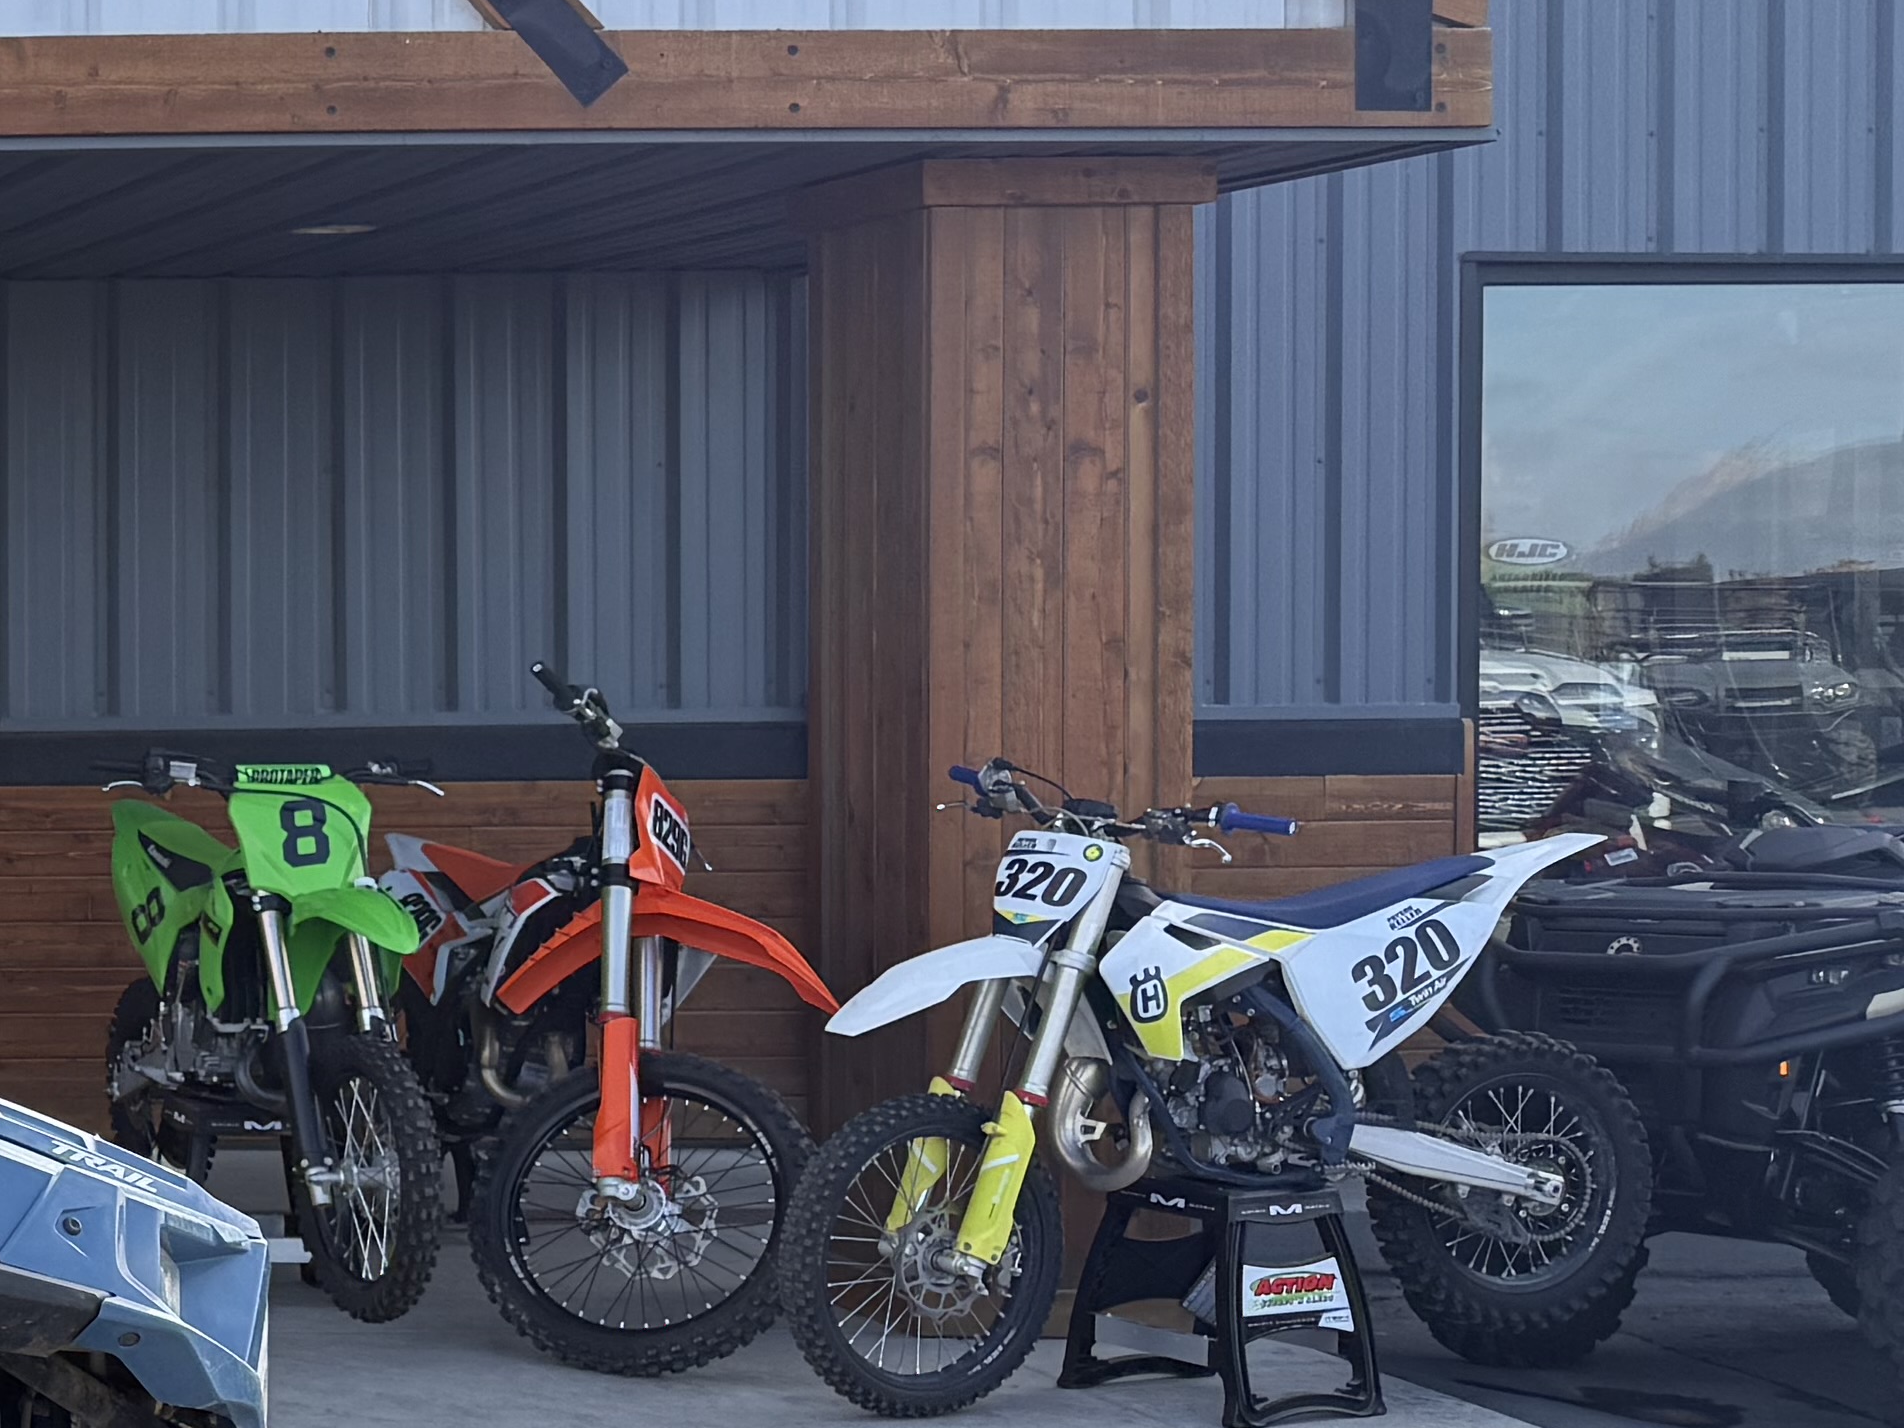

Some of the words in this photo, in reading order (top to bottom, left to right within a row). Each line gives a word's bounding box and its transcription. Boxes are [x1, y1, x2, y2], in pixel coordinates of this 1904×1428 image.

[1494, 543, 1561, 558] HJC
[279, 798, 330, 868] 8
[995, 858, 1088, 907] 320
[1351, 919, 1460, 1012] 320
[51, 1140, 158, 1194] TRAIL
[1254, 1273, 1336, 1297] ACTION
